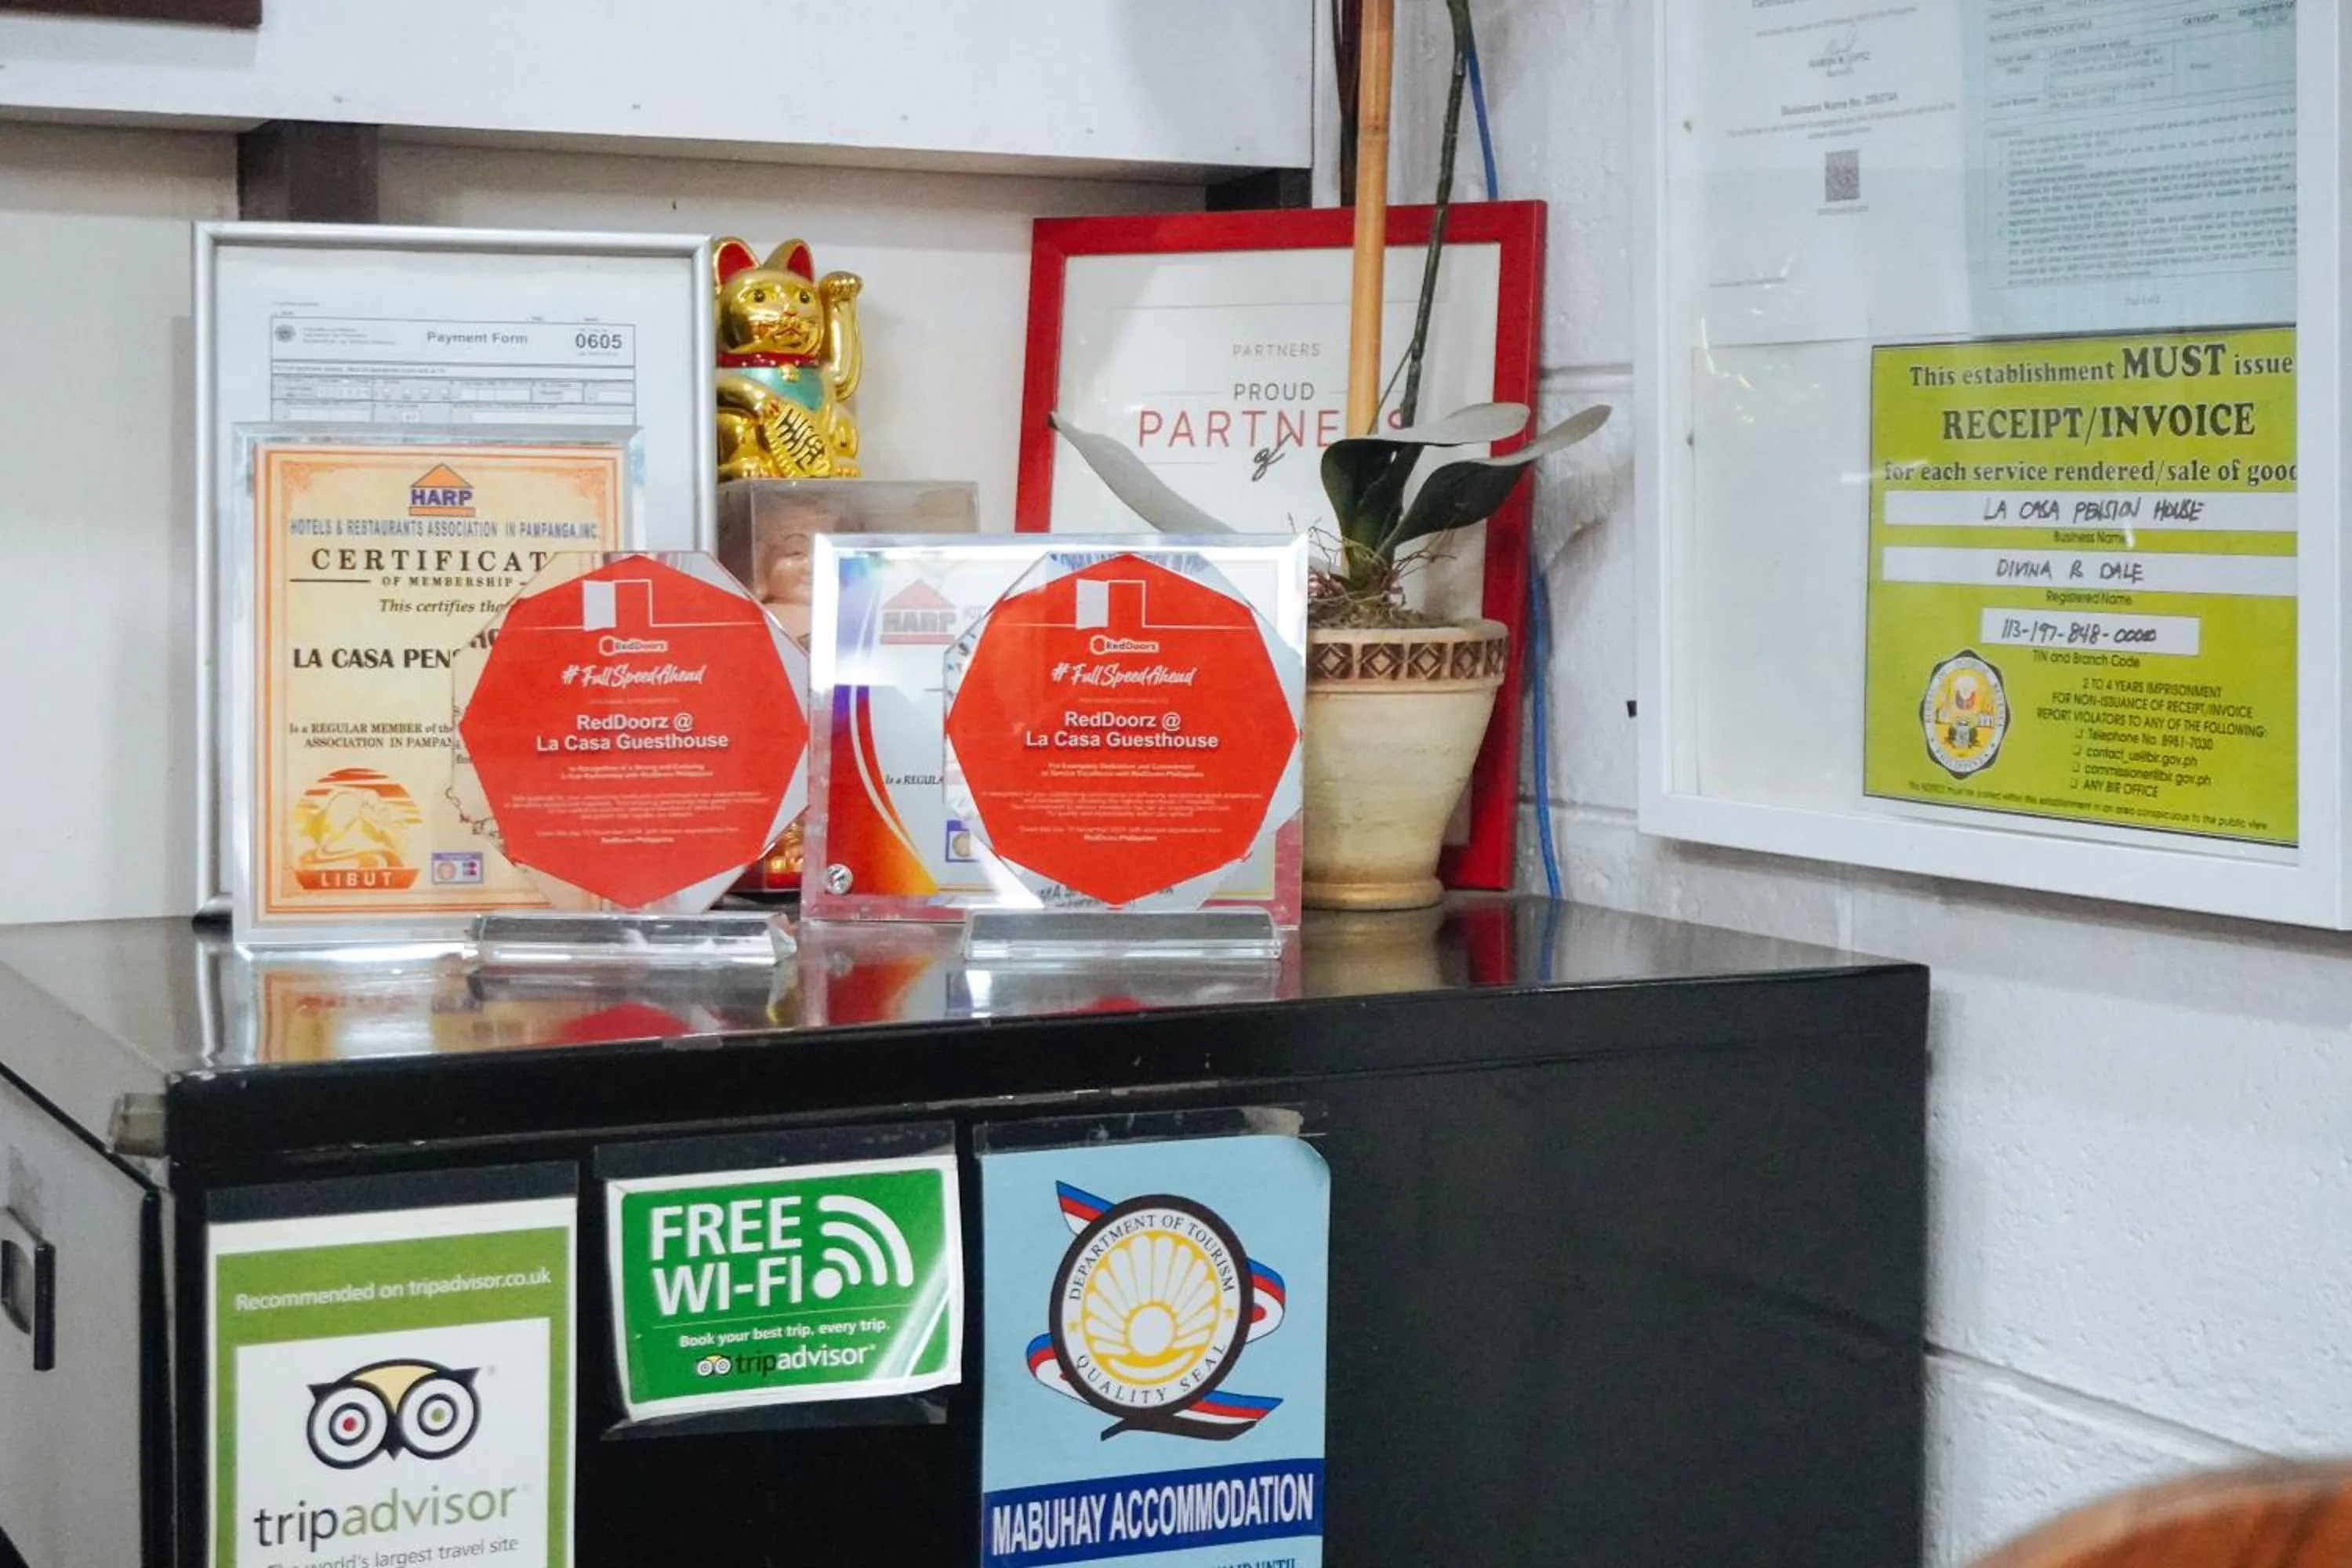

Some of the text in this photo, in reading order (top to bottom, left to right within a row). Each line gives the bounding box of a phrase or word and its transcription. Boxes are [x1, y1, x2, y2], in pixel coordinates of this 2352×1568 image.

[427, 330, 528, 347] Payment Form
[575, 332, 622, 350] 0605
[1232, 343, 1321, 357] PARTNERS
[1911, 343, 2293, 387] This establishment MUST issue
[1233, 382, 1315, 401] PROUD
[1943, 401, 2256, 445] RECEIPT/INVOICE
[1885, 460, 1914, 481] for
[1921, 460, 1966, 481] each
[1973, 461, 2047, 481] service
[2054, 459, 2209, 486] rendered/sale
[2218, 458, 2241, 481] of
[411, 488, 473, 507] HARP
[1984, 497, 2007, 521] LA
[2019, 499, 2060, 521] CASA
[2153, 499, 2205, 522] HOUSE
[290, 518, 332, 535] HOTELS
[346, 519, 423, 537] RESTAURANTS
[427, 521, 497, 539] ASSOCIATION
[506, 522, 517, 538] IN
[2054, 529, 2095, 543] Business
[311, 548, 548, 572] CERTIFICAT
[1996, 558, 2145, 583] DIVINA R DALE
[382, 576, 514, 588] OF MEMBERSHIP
[379, 598, 412, 613] This
[416, 597, 475, 617] certifies
[2045, 589, 2132, 606] Registered Name
[883, 611, 957, 633] HARP
[293, 648, 323, 668] LA
[332, 648, 394, 669] CASA
[2033, 650, 2141, 669] TIN and Branch Code
[1052, 662, 1197, 688] #FullSpeedAhead
[2082, 677, 2223, 699] 2 TO 4 YEARS IMPRISONMENT
[2052, 691, 2253, 719] FOR NON-ISSUANCE OF RECEIPT/INVOICE
[311, 723, 367, 735] REGULAR
[370, 723, 423, 735] MEMBER
[425, 722, 436, 734] of
[576, 713, 693, 732] RedDoorz @
[1064, 711, 1181, 731] RedDoorz @
[2037, 707, 2071, 720] REPORT
[2074, 711, 2125, 727] VIOLATORS
[2129, 714, 2141, 727] TO
[2143, 717, 2165, 729] ANY
[2167, 718, 2181, 730] OF
[2183, 719, 2201, 732] THE
[305, 738, 383, 749] ASSOCIATION
[391, 738, 403, 749] IN
[536, 732, 728, 753] La Casa Guesthouse
[1025, 731, 1218, 748] La Casa Guesthouse
[2088, 728, 2140, 743] Telephone
[2083, 779, 2158, 798] ANY BIR OFFICE
[320, 871, 393, 887] LIBUT
[650, 1195, 802, 1261] FREE
[1069, 1214, 1236, 1301] DEPARTMENT OF TOURISM
[236, 1265, 552, 1312] Recommended on tripadvisor.co.uk
[652, 1254, 803, 1316] WI-FI
[679, 1333, 715, 1348] Book
[717, 1332, 750, 1348] your
[753, 1327, 783, 1341] best
[818, 1320, 858, 1336] every
[860, 1317, 891, 1334] trip.
[735, 1345, 868, 1377] tripadvisor
[1076, 1343, 1228, 1404] QUALITY SEAL
[253, 1483, 517, 1553] tripadvisor
[992, 1472, 1314, 1557] MABUHAY ACCOMMODATION
[376, 1548, 433, 1568] largest
[438, 1539, 485, 1560] travel
[489, 1537, 519, 1554] site
